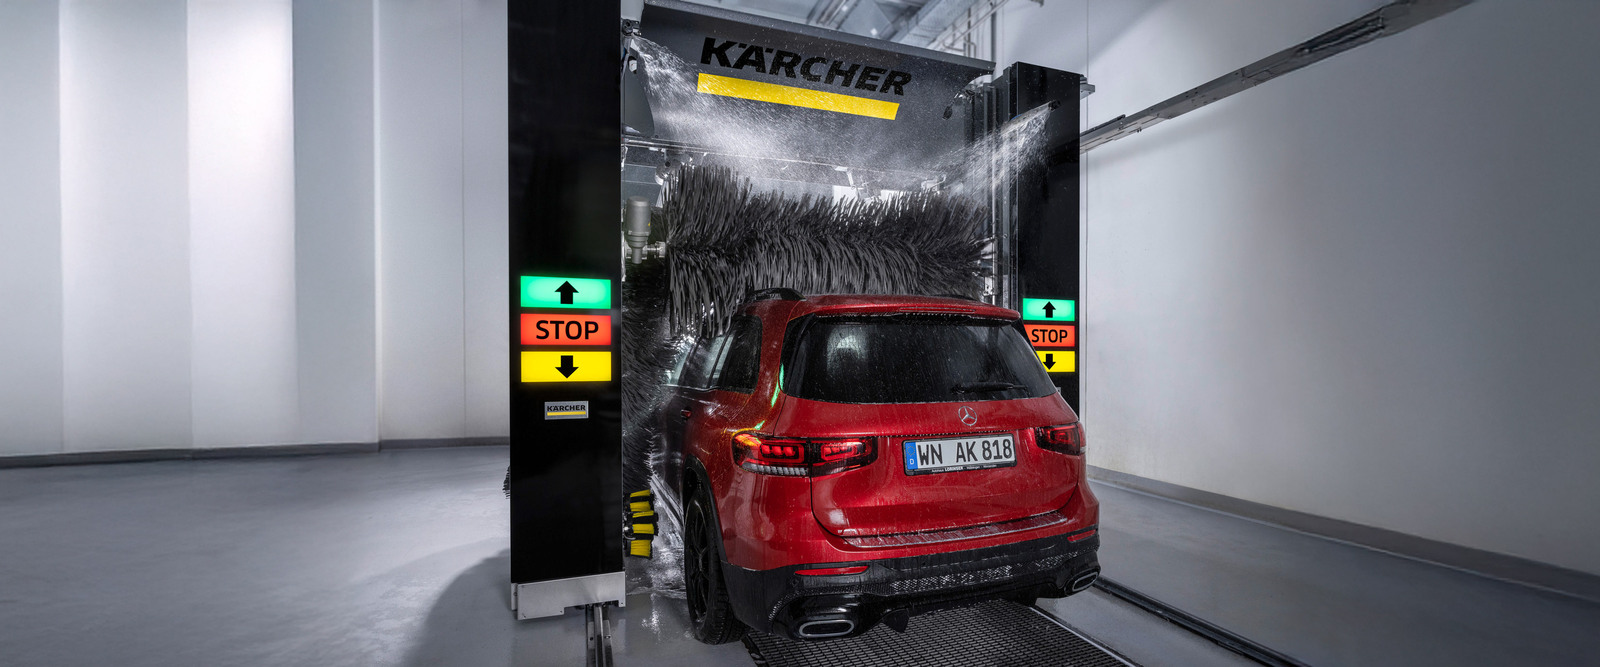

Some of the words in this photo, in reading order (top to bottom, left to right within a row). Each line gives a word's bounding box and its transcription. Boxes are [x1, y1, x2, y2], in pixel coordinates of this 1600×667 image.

[700, 37, 912, 96] KÄRCHER
[536, 320, 599, 340] STOP
[1031, 329, 1068, 343] STOP
[546, 404, 586, 412] KÄRCHER
[918, 444, 943, 465] WN
[956, 441, 978, 463] AK
[982, 439, 1012, 460] 818
